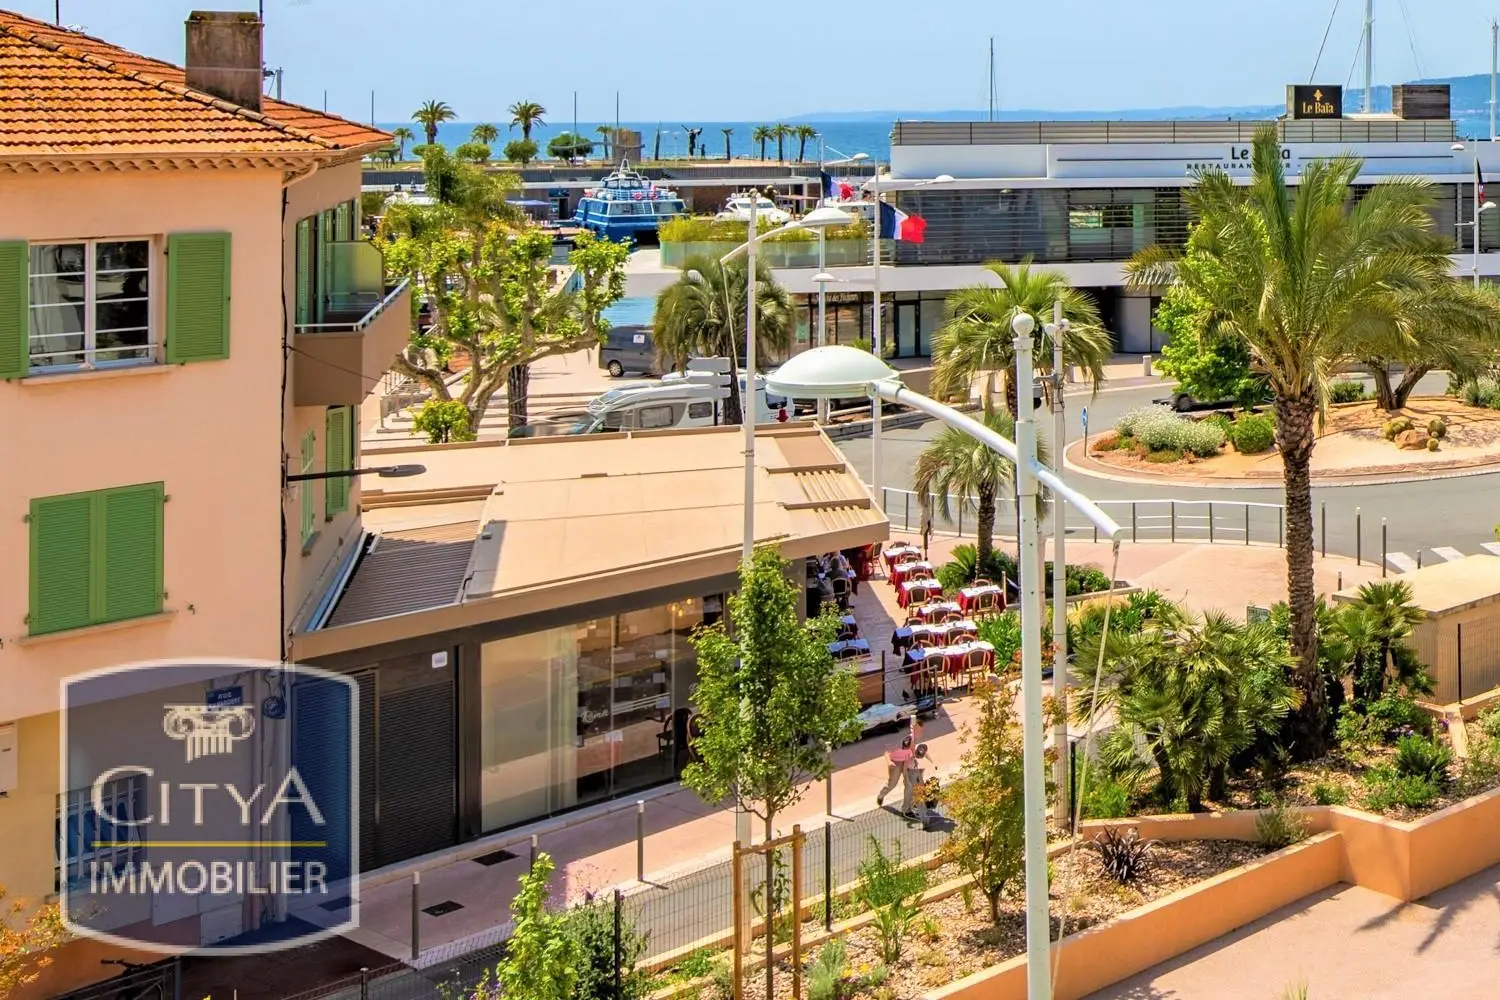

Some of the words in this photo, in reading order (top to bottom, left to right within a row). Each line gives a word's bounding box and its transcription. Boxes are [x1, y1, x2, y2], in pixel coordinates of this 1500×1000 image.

[1302, 101, 1313, 114] Le
[1315, 101, 1334, 114] Baïa
[1231, 146, 1249, 160] Le
